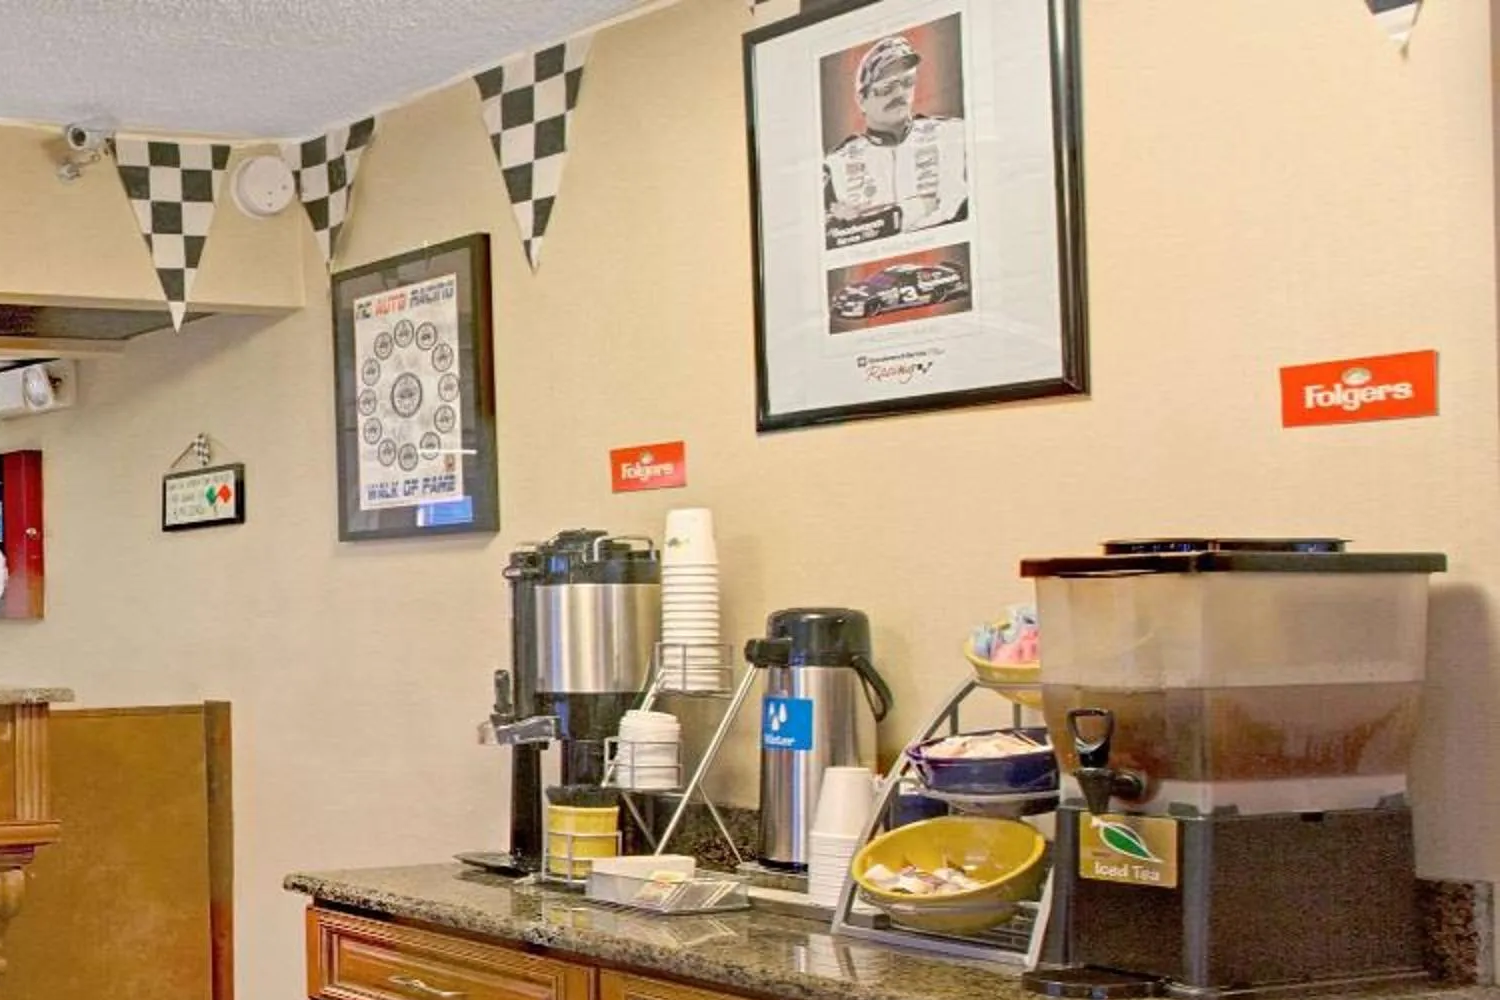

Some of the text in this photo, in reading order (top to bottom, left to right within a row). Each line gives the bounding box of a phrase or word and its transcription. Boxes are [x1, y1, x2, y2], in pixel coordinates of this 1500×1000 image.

[1303, 382, 1414, 412] Folgers
[621, 461, 674, 482] Folgers
[1094, 861, 1160, 881] Iced Tea
